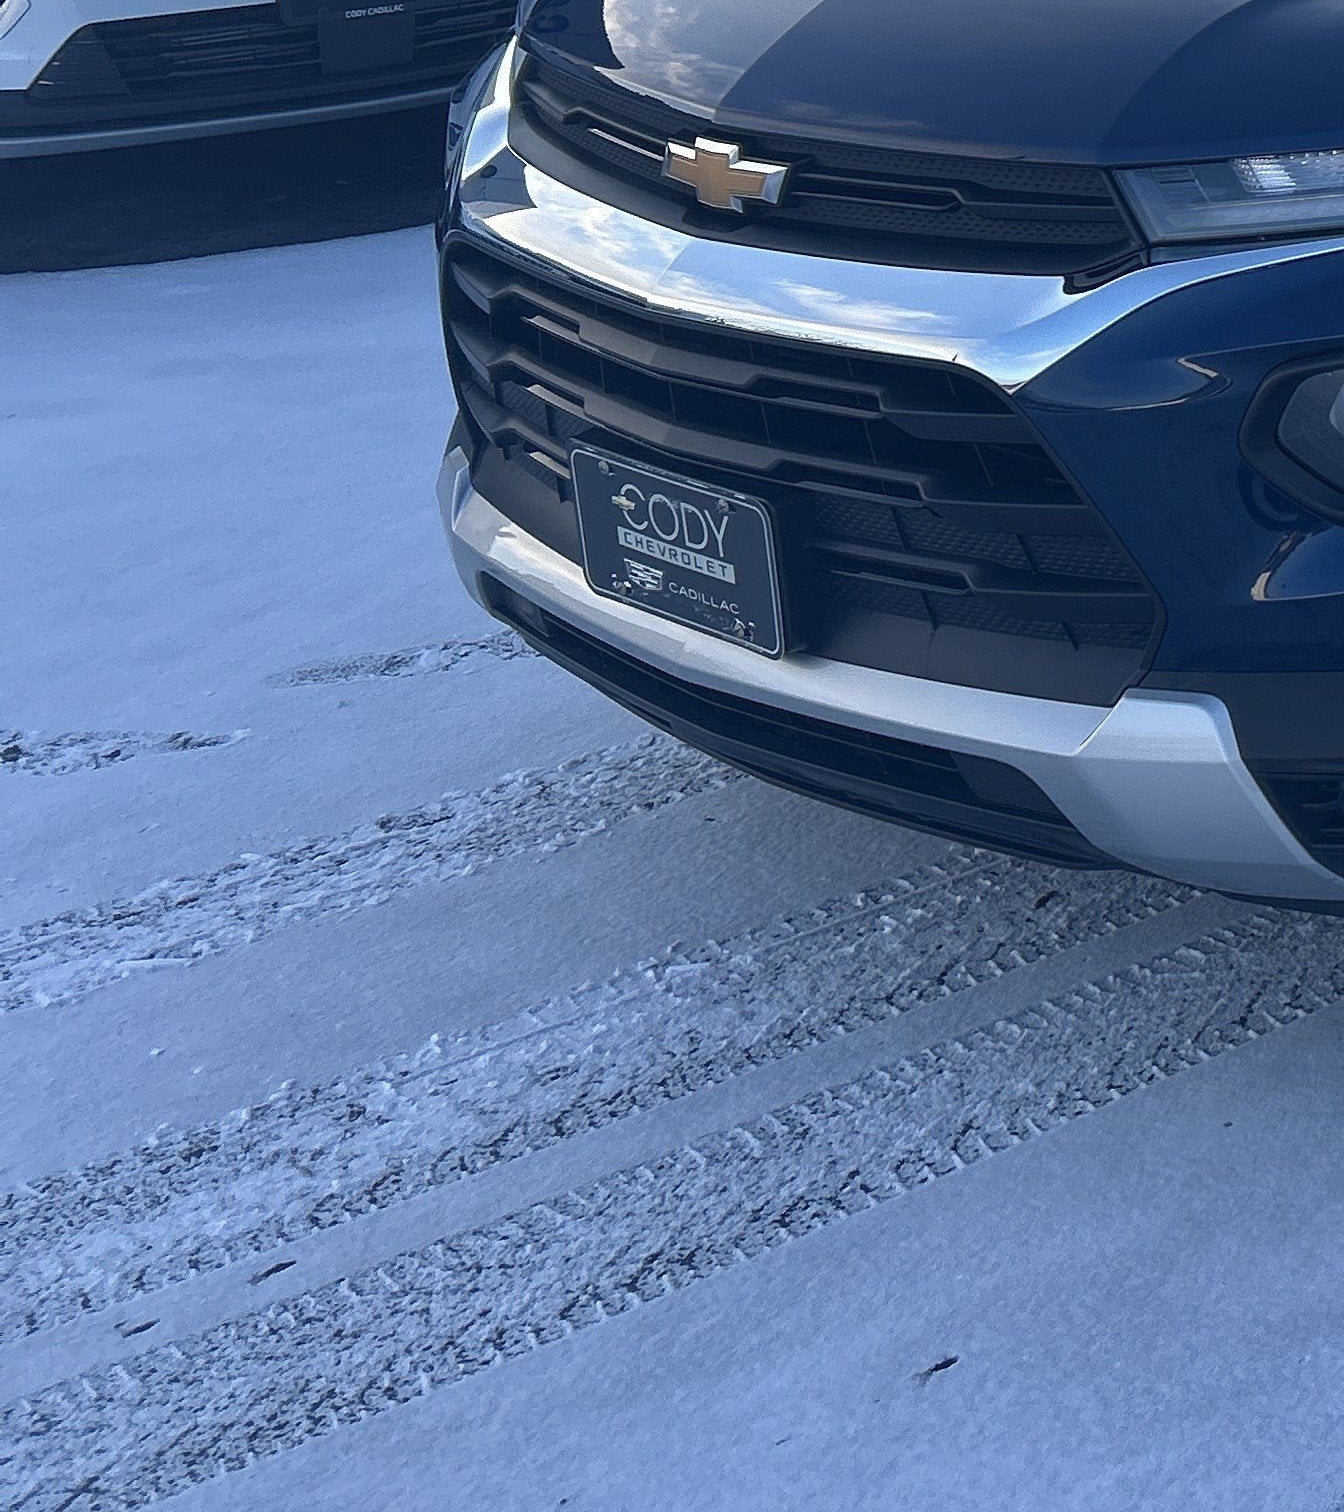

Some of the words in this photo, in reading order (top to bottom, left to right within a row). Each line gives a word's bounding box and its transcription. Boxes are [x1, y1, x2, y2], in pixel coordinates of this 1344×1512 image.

[618, 483, 729, 558] CODY
[623, 530, 729, 579] CHEVROLET
[668, 582, 740, 615] CADILLAC
